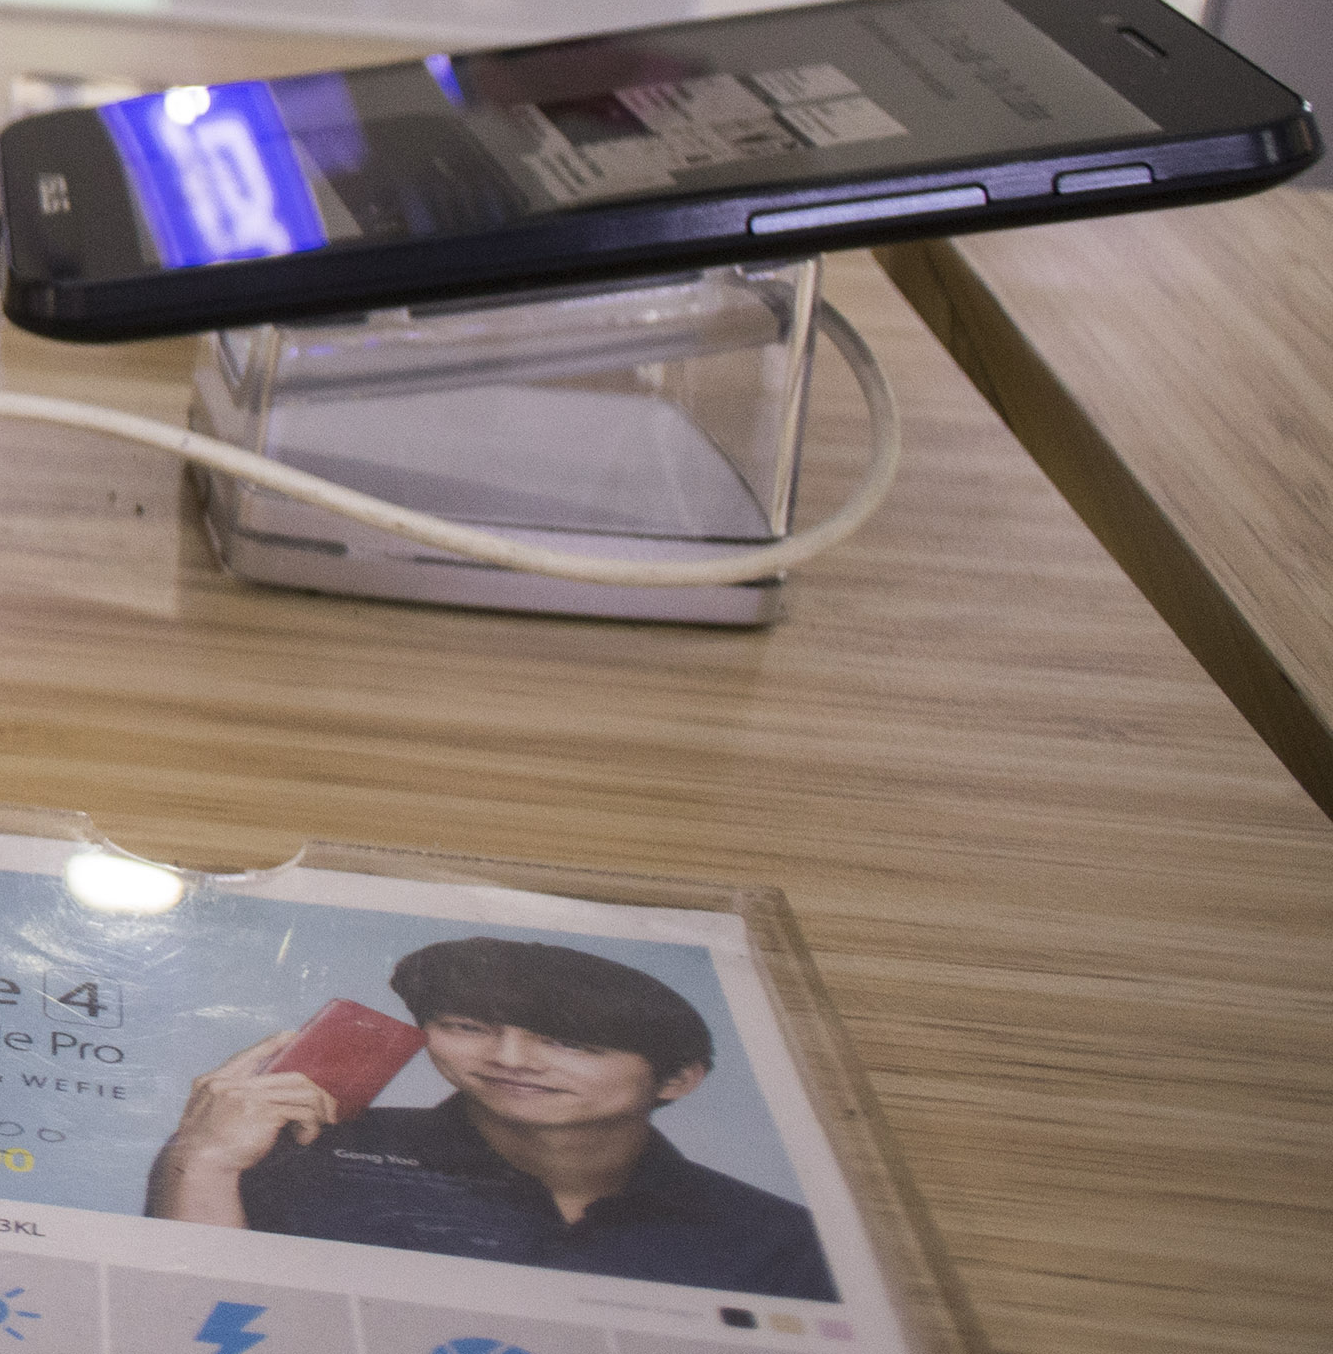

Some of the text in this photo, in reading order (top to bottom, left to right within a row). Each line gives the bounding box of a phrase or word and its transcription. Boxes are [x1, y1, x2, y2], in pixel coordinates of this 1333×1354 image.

[56, 981, 107, 1018] 4
[51, 1031, 125, 1065] Pro
[22, 1073, 128, 1100] WEFIE
